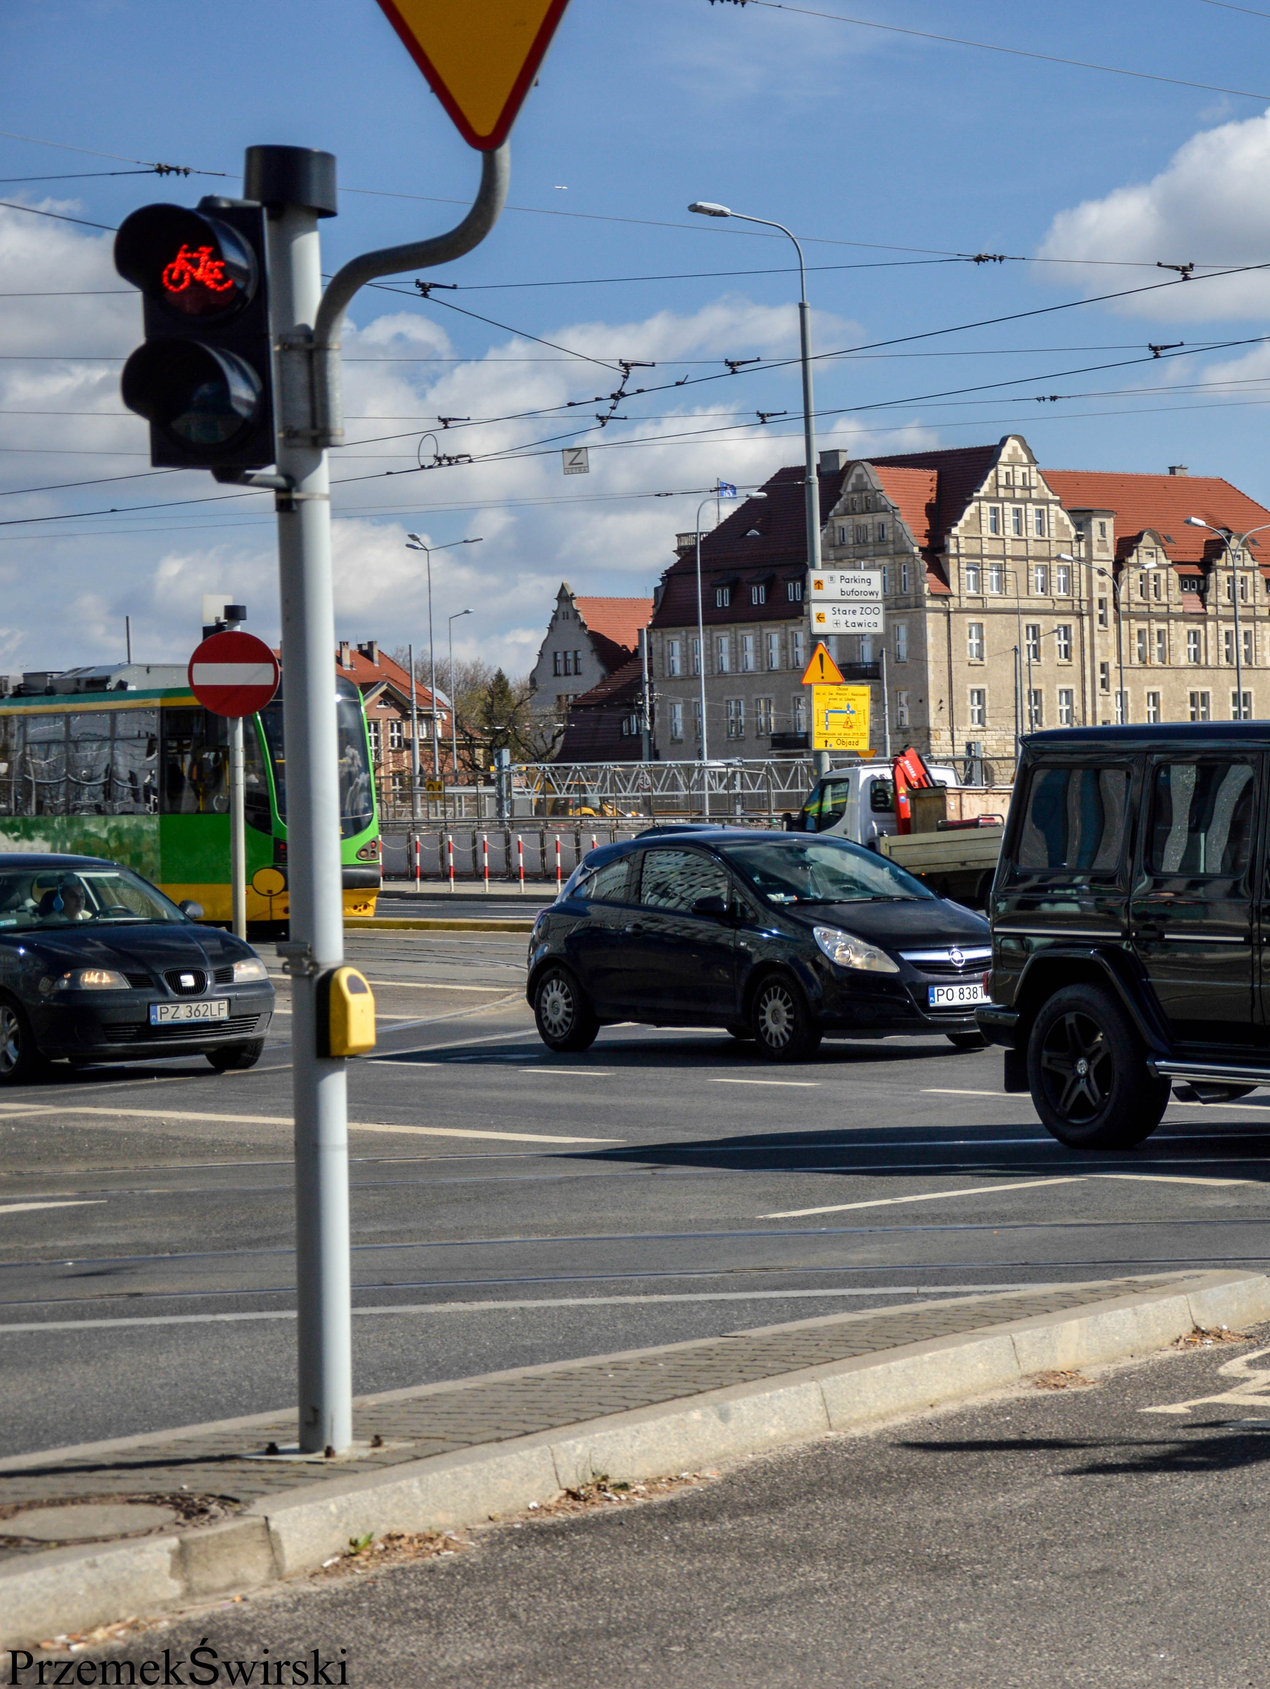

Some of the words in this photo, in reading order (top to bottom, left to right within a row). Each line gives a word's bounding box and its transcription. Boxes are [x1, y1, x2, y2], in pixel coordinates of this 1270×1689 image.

[839, 575, 872, 586] Parking
[840, 588, 879, 598] buforowy
[831, 606, 857, 615] Stare
[859, 606, 881, 615] ZOO
[844, 619, 878, 628] Ławica
[836, 738, 859, 747] Objazd
[936, 988, 954, 1003] PO
[958, 986, 987, 1001] 838T
[159, 1005, 180, 1020] PZ
[185, 1002, 226, 1018] 362LF
